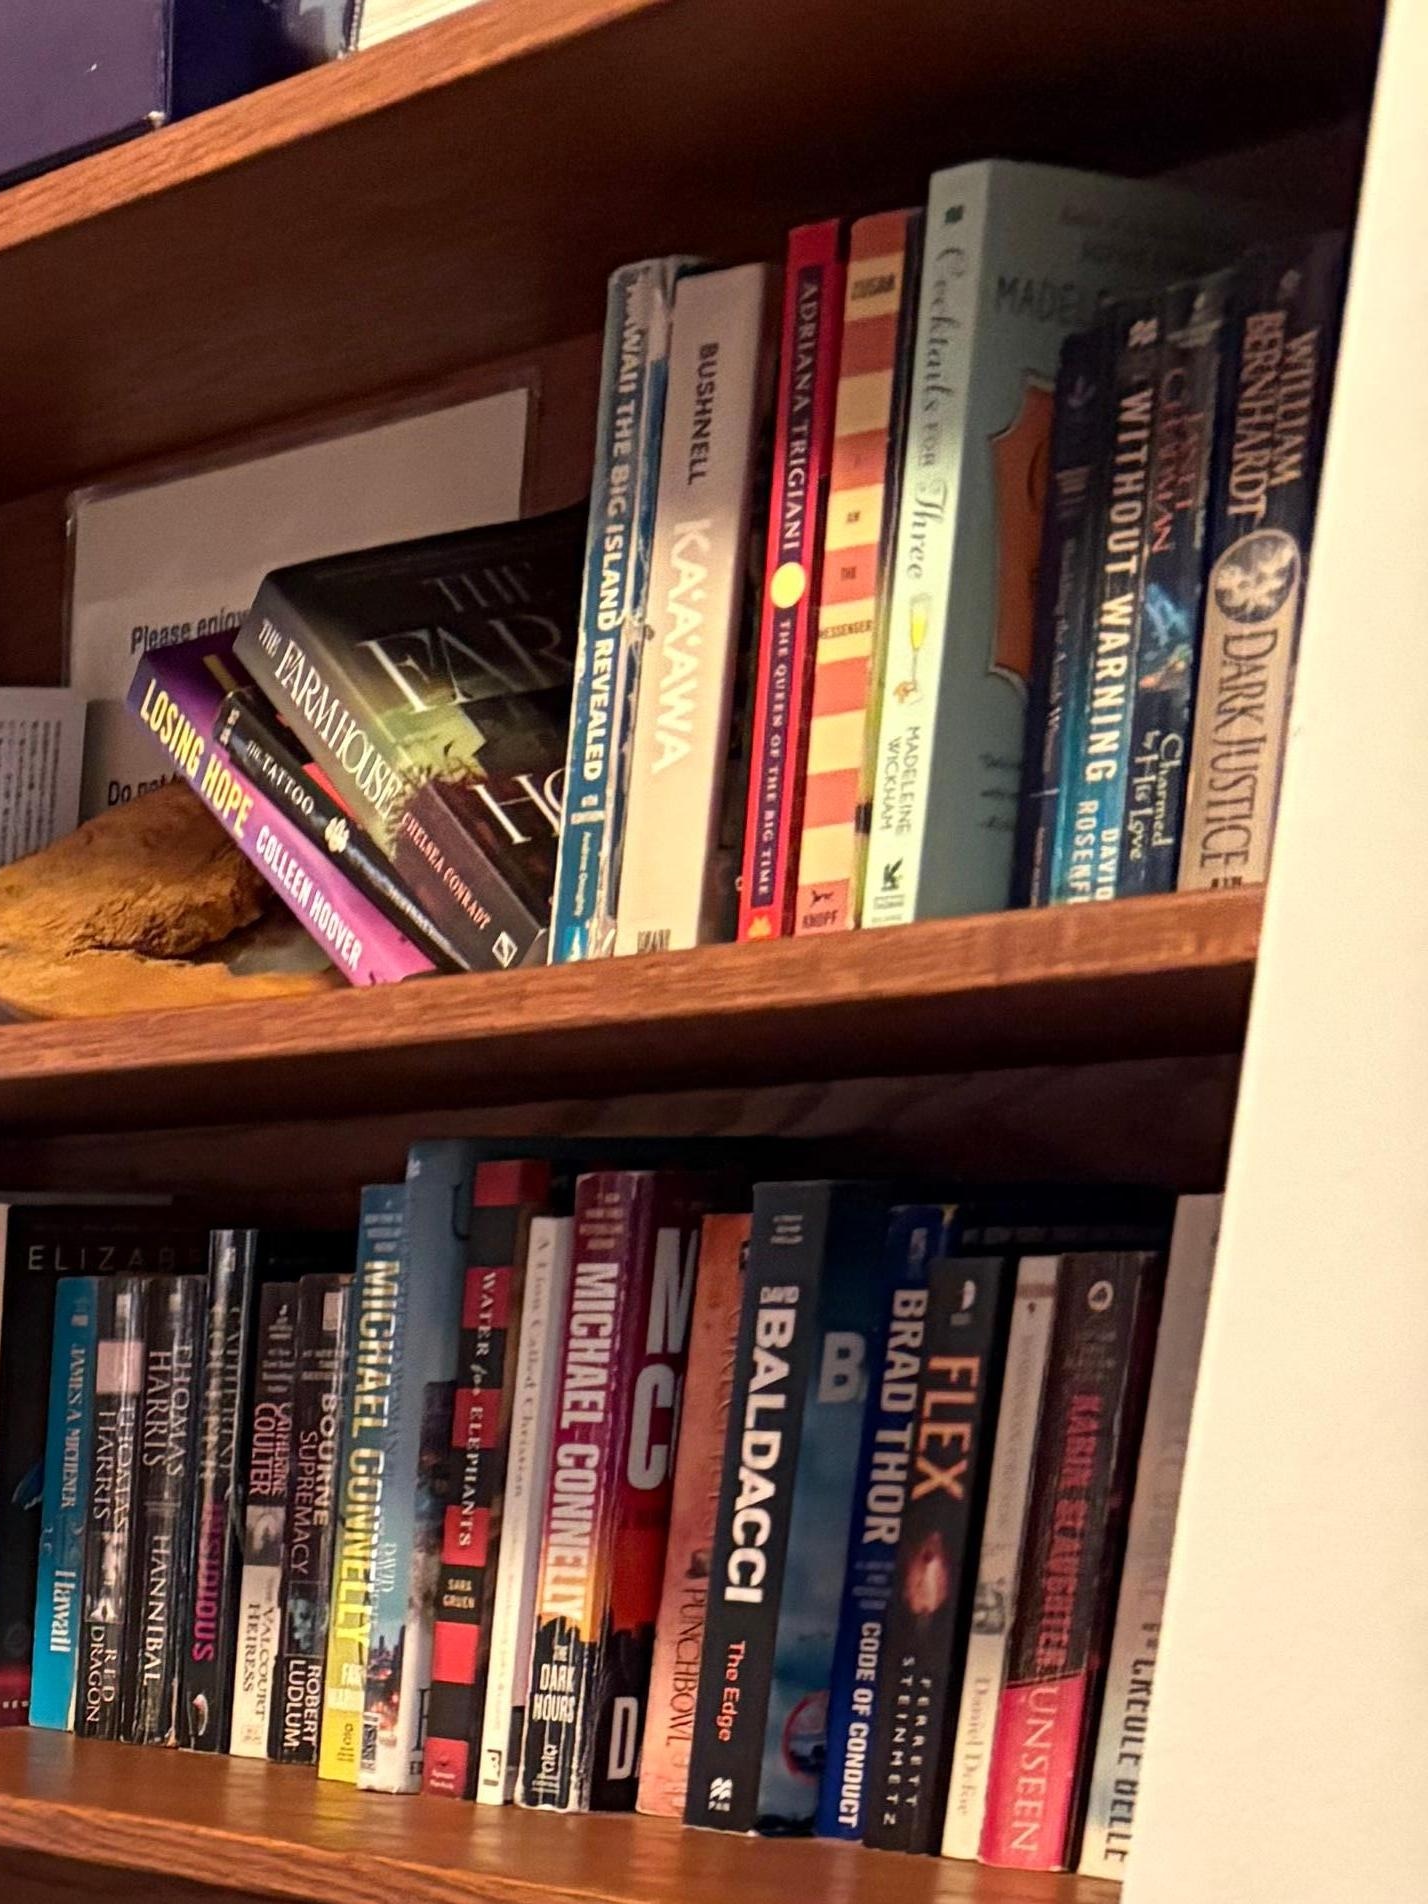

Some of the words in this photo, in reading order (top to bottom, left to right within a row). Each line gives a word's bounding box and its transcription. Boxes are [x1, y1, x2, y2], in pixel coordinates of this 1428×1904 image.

[789, 278, 819, 409] ADRIANA
[614, 397, 635, 443] THE
[687, 343, 719, 486] BUSHNELL
[608, 461, 632, 520] BIG
[783, 408, 809, 552] TRIGIANI
[1106, 388, 1155, 578] WITHOUT
[598, 521, 626, 635] ISLAND
[131, 619, 190, 656] Please
[1087, 592, 1136, 784] WARNING
[1219, 624, 1279, 727] DARK
[140, 678, 206, 781] LOSING
[201, 752, 255, 839] HOPE
[258, 617, 282, 659] THE
[274, 639, 406, 820] FARMHOUSE
[582, 637, 615, 783] REVEALED
[262, 752, 315, 817] TATTOO
[880, 737, 903, 833] WICKHAM
[894, 726, 922, 838] MADELEINE
[1198, 728, 1268, 875] JUSTICE
[255, 824, 314, 909] COLLEEN
[309, 889, 363, 972] HOOVER
[400, 811, 444, 876] CHELSEA
[802, 908, 839, 930] KNOPF
[351, 1259, 401, 1440] MICHAEL
[475, 1272, 498, 1357] WATER
[560, 1262, 620, 1430] MICHAEL
[880, 1288, 929, 1413] BRAD
[93, 1410, 118, 1521] HARRIS
[142, 1350, 173, 1467] HARRIS
[165, 1340, 193, 1477] THOMAS
[249, 1402, 279, 1497] COULTER
[313, 1393, 339, 1528] BOURNE
[723, 1307, 797, 1604] BALDACCI
[910, 1355, 981, 1501] FLEX
[290, 1430, 319, 1576] SUPREMACY
[459, 1406, 485, 1548] ELEPHANTS
[543, 1442, 602, 1625] CONNELLY
[861, 1421, 914, 1546] THOR
[334, 1447, 386, 1649] CONNELLY
[49, 1570, 77, 1653] Hawaii
[143, 1535, 171, 1687] HANNIBAL
[242, 1601, 261, 1693] HEIRESS
[255, 1605, 275, 1723] VALCOURT
[726, 1640, 747, 1681] The
[855, 1621, 883, 1682] CODE
[86, 1624, 105, 1723] DRAGON
[102, 1648, 118, 1703] RED
[284, 1659, 306, 1749] LUDLUM
[303, 1664, 323, 1754] ROBERT
[531, 1695, 576, 1724] HOURS
[538, 1664, 575, 1693] DARK
[716, 1687, 741, 1742] Edge
[851, 1687, 874, 1717] OF
[837, 1722, 870, 1829] CONDUCT
[1009, 1685, 1060, 1854] UNSEEN
